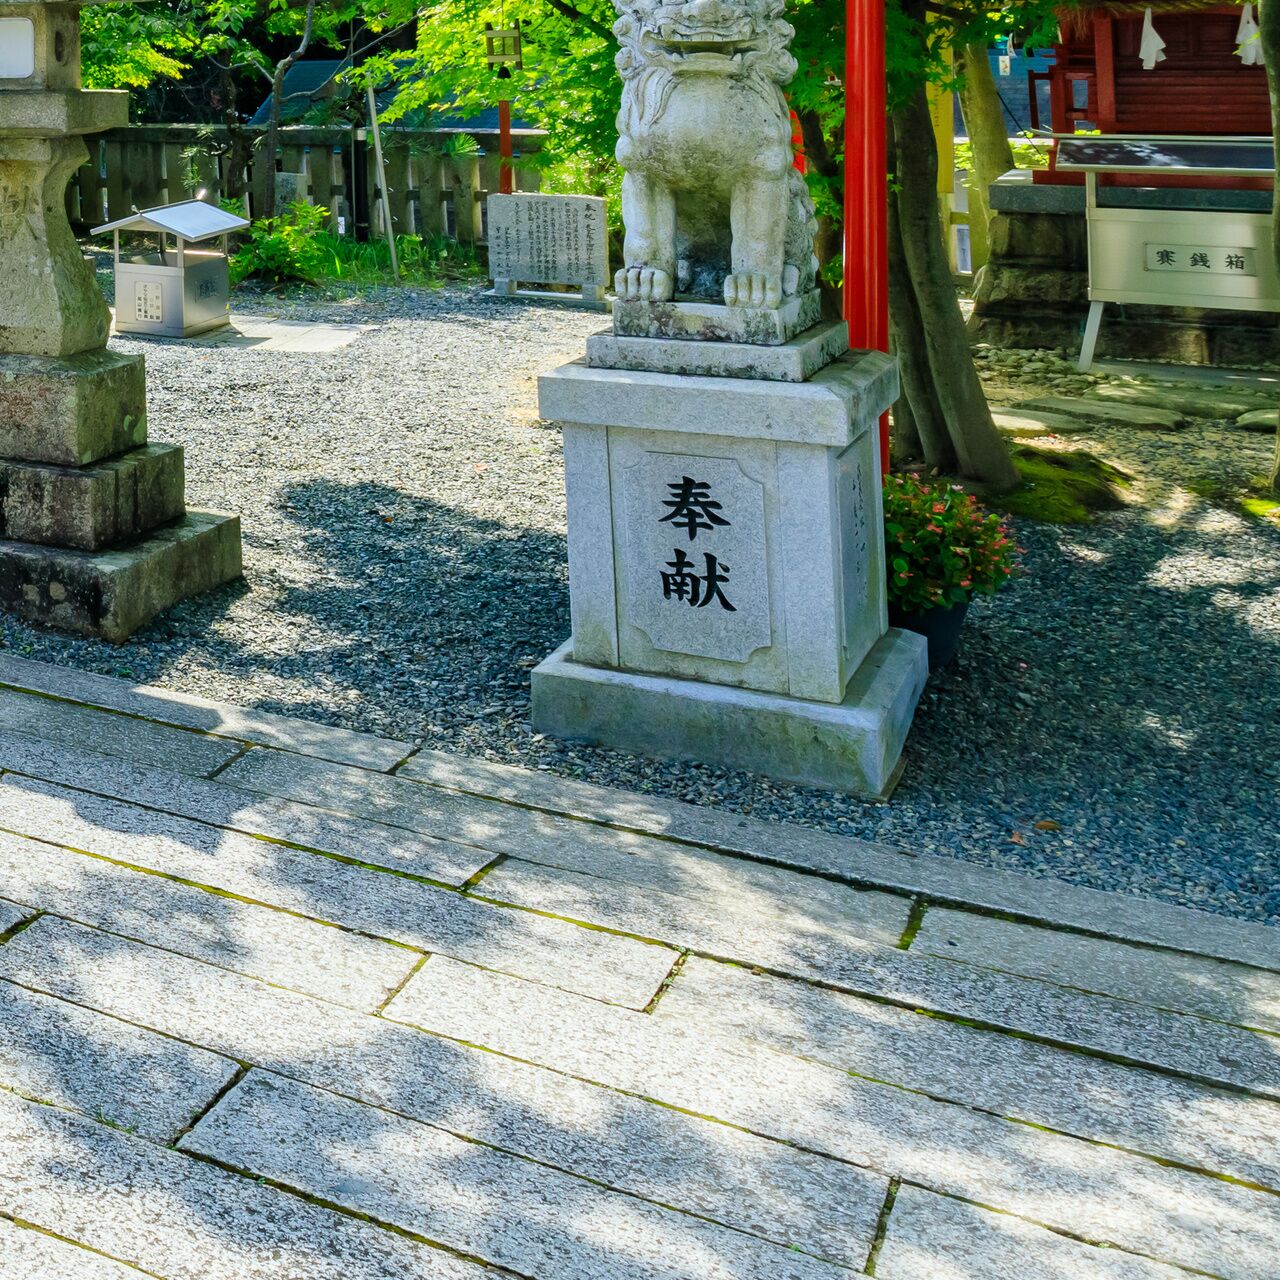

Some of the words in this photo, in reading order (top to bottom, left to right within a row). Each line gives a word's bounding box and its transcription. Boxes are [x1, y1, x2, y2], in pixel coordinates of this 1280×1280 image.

[1155, 249, 1247, 271] 賽銭箱
[657, 475, 738, 612] 奉献
